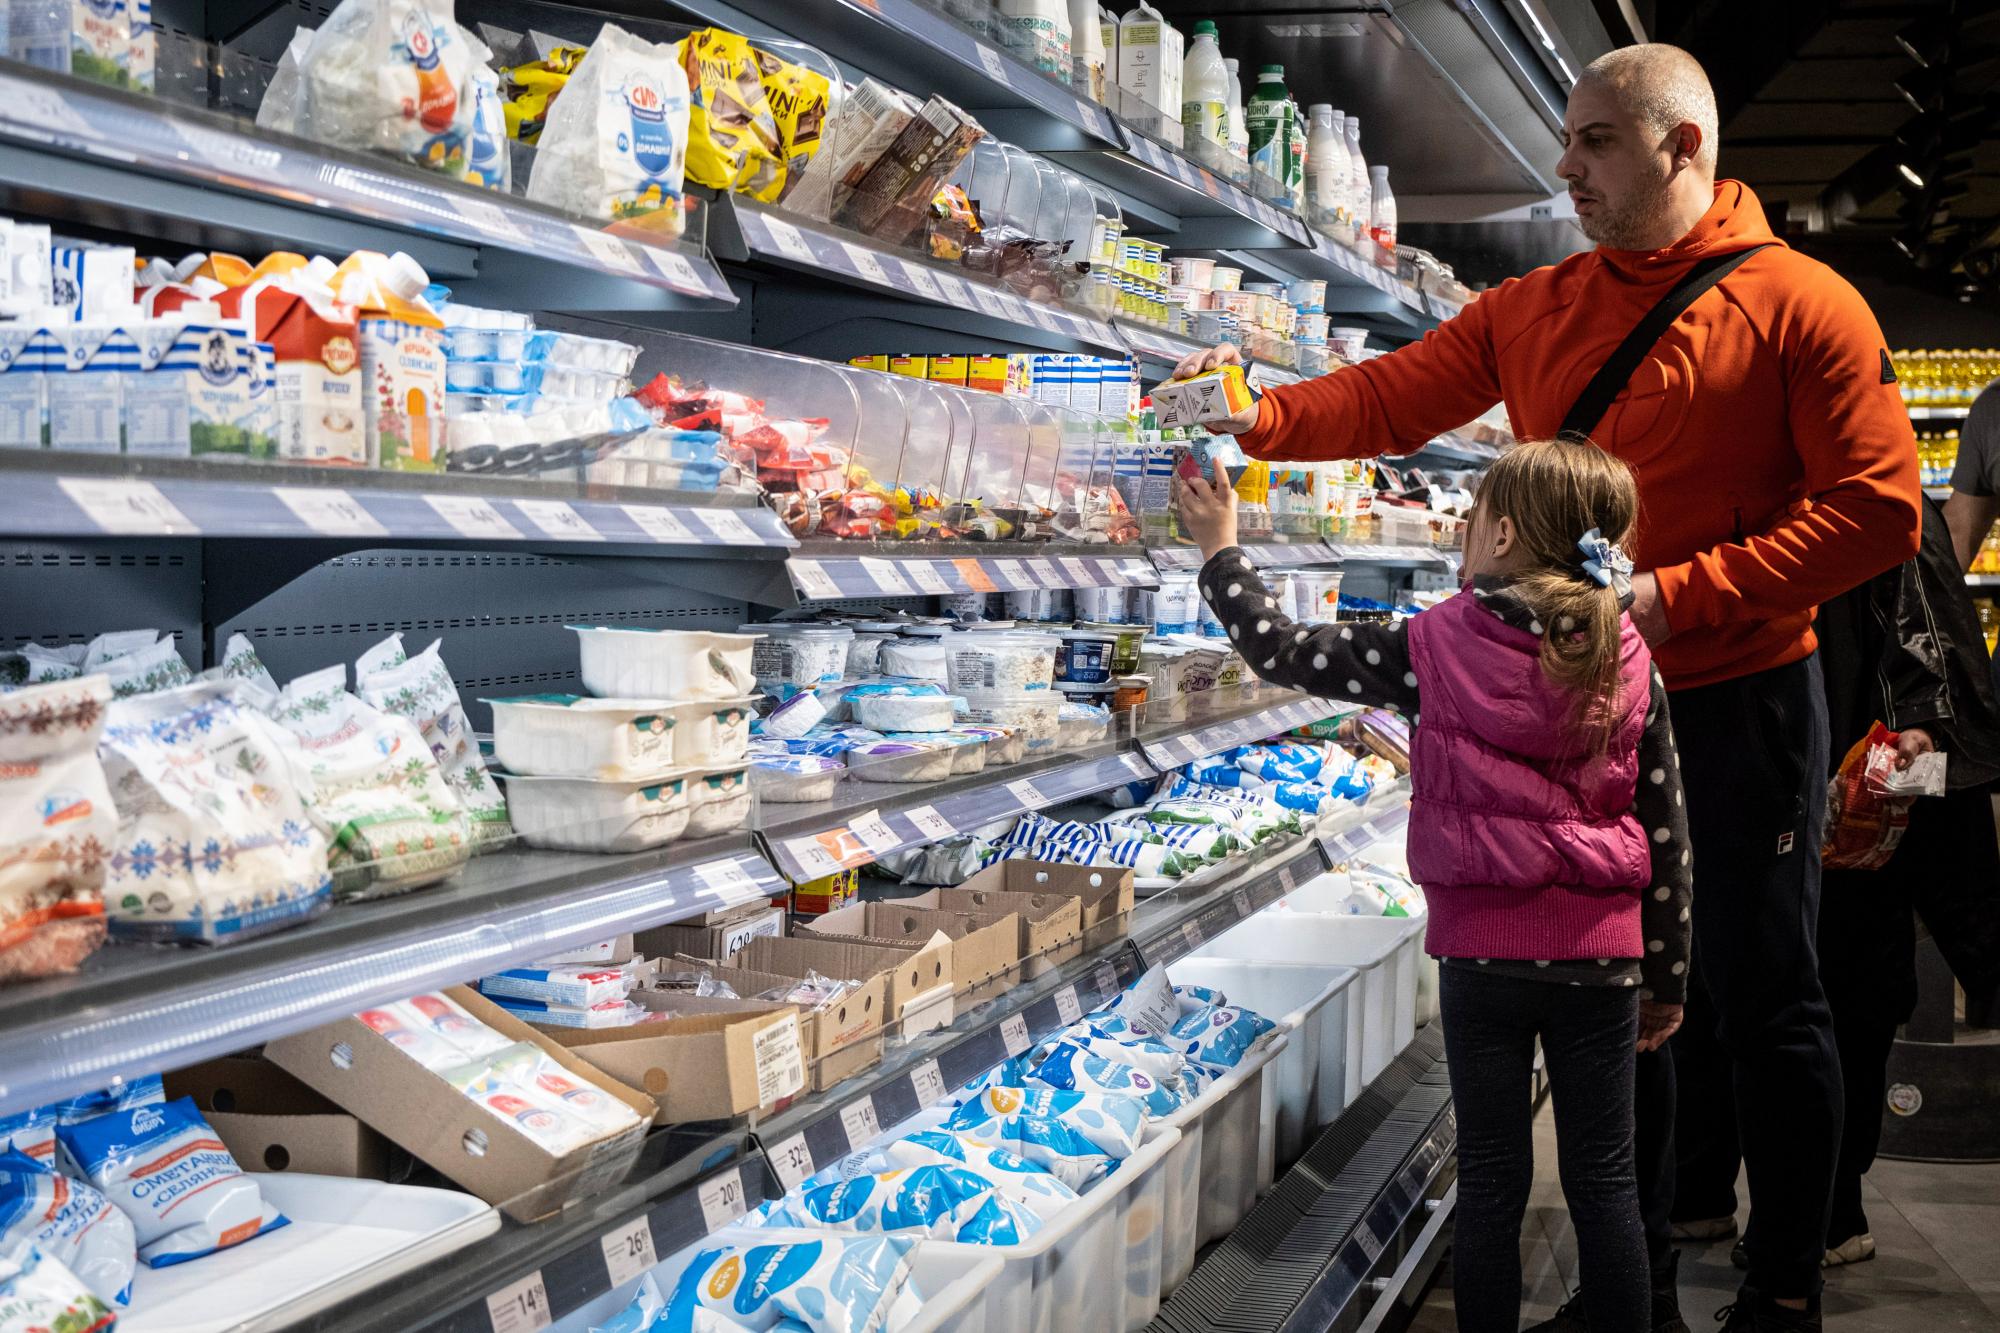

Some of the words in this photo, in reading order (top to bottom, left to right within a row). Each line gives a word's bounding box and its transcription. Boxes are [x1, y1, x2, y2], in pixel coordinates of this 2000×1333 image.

[632, 86, 658, 107] СИР
[787, 1146, 804, 1169] 32
[719, 1185, 736, 1207] 20
[626, 1233, 644, 1258] 26
[517, 1288, 537, 1316] 14
